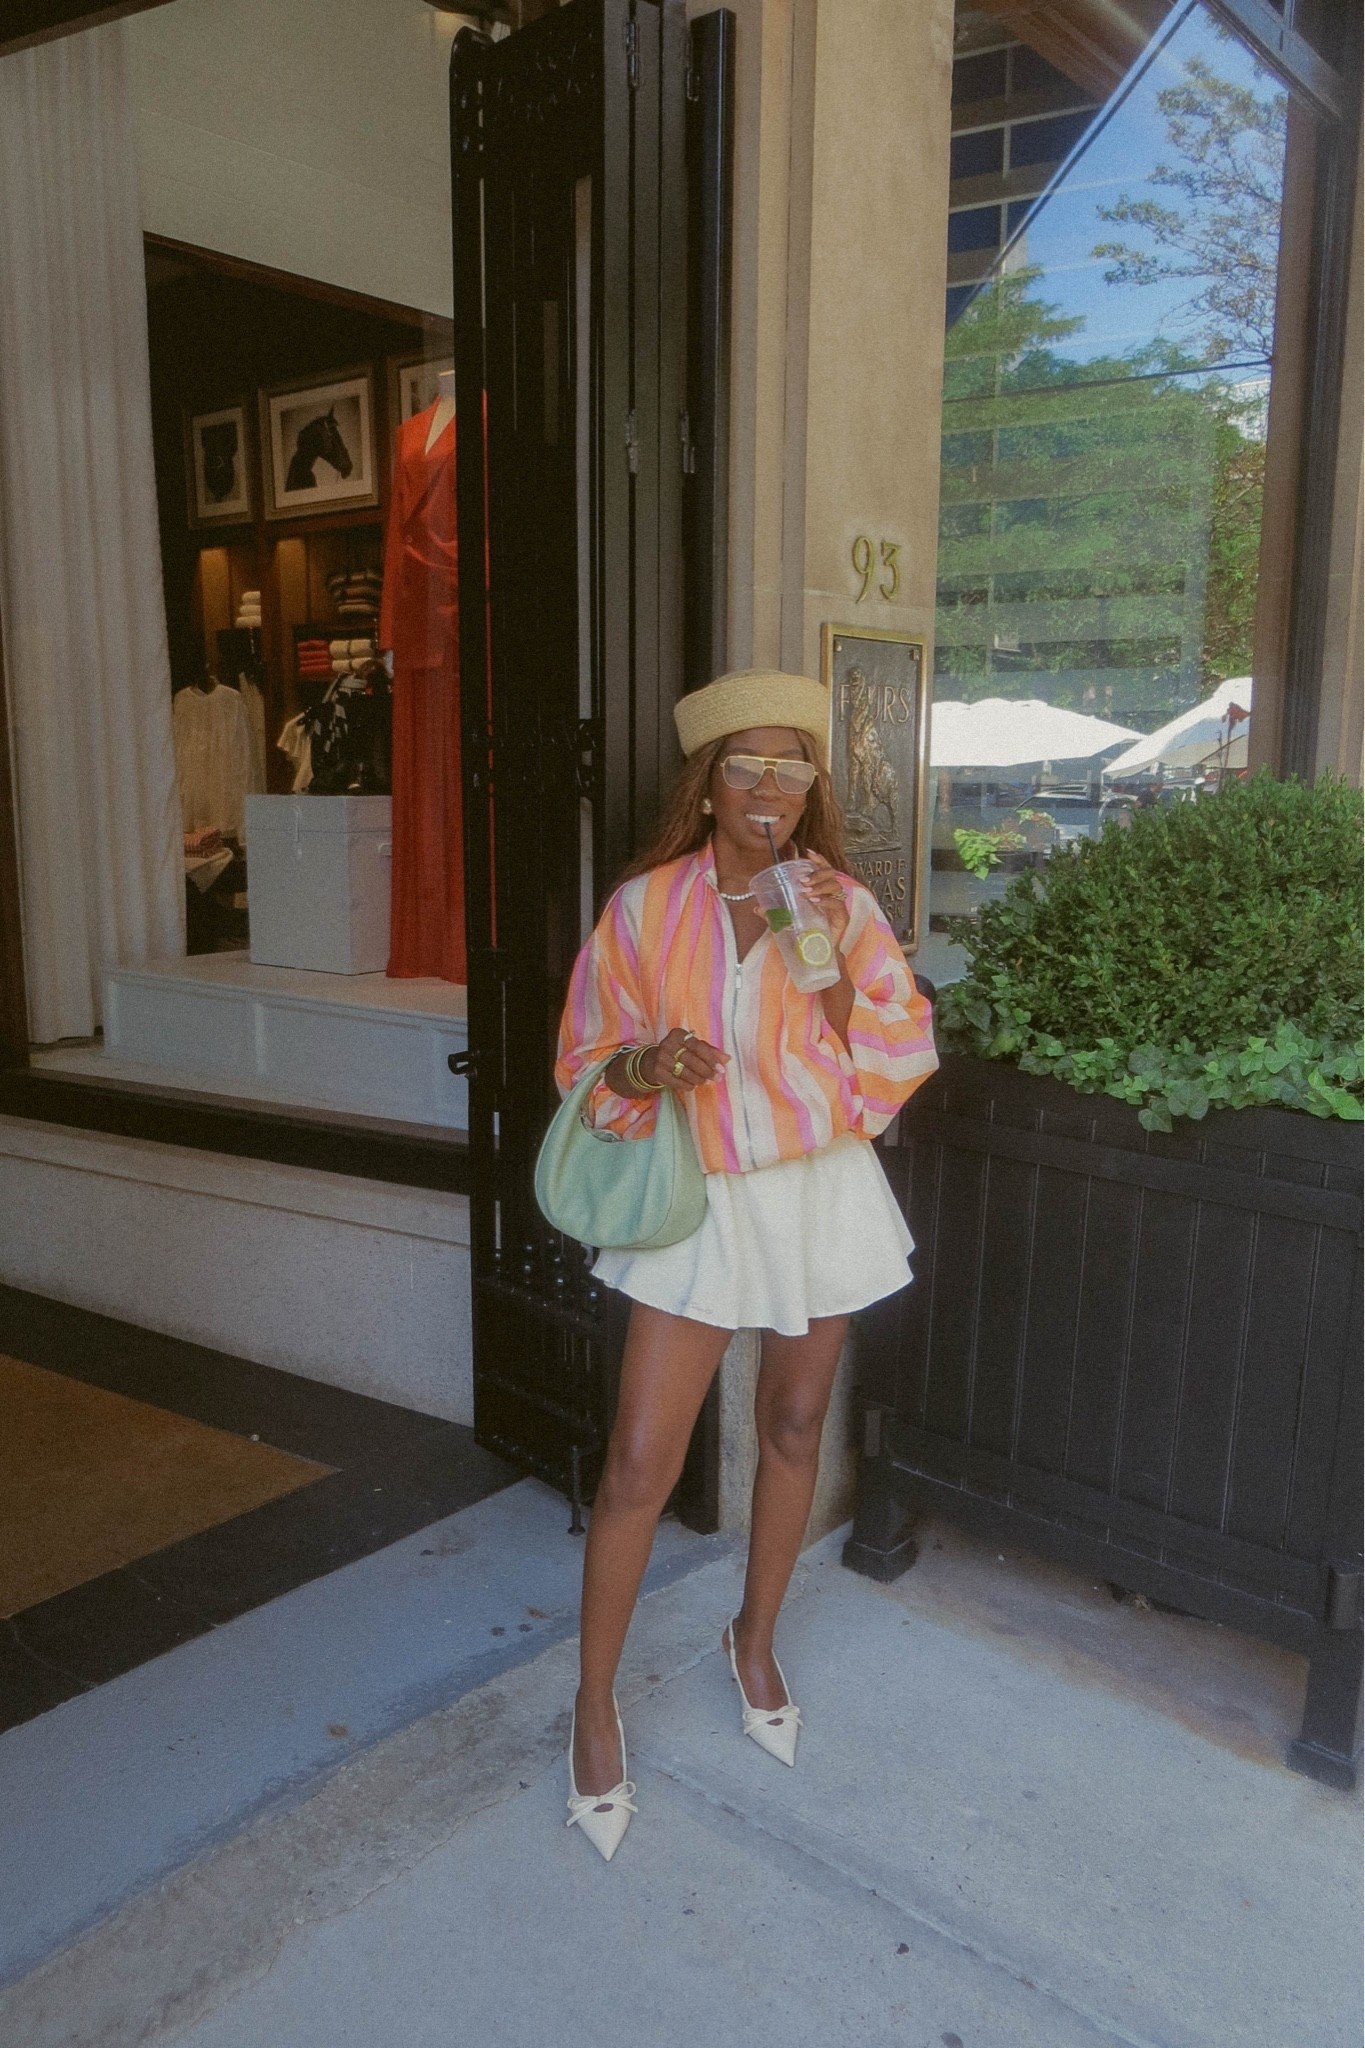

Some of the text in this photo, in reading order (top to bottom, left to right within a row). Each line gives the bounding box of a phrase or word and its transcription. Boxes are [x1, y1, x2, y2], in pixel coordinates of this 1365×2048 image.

[852, 536, 901, 604] 93
[840, 684, 909, 725] FURS
[853, 860, 892, 876] WARD
[868, 876, 906, 901] KAS
